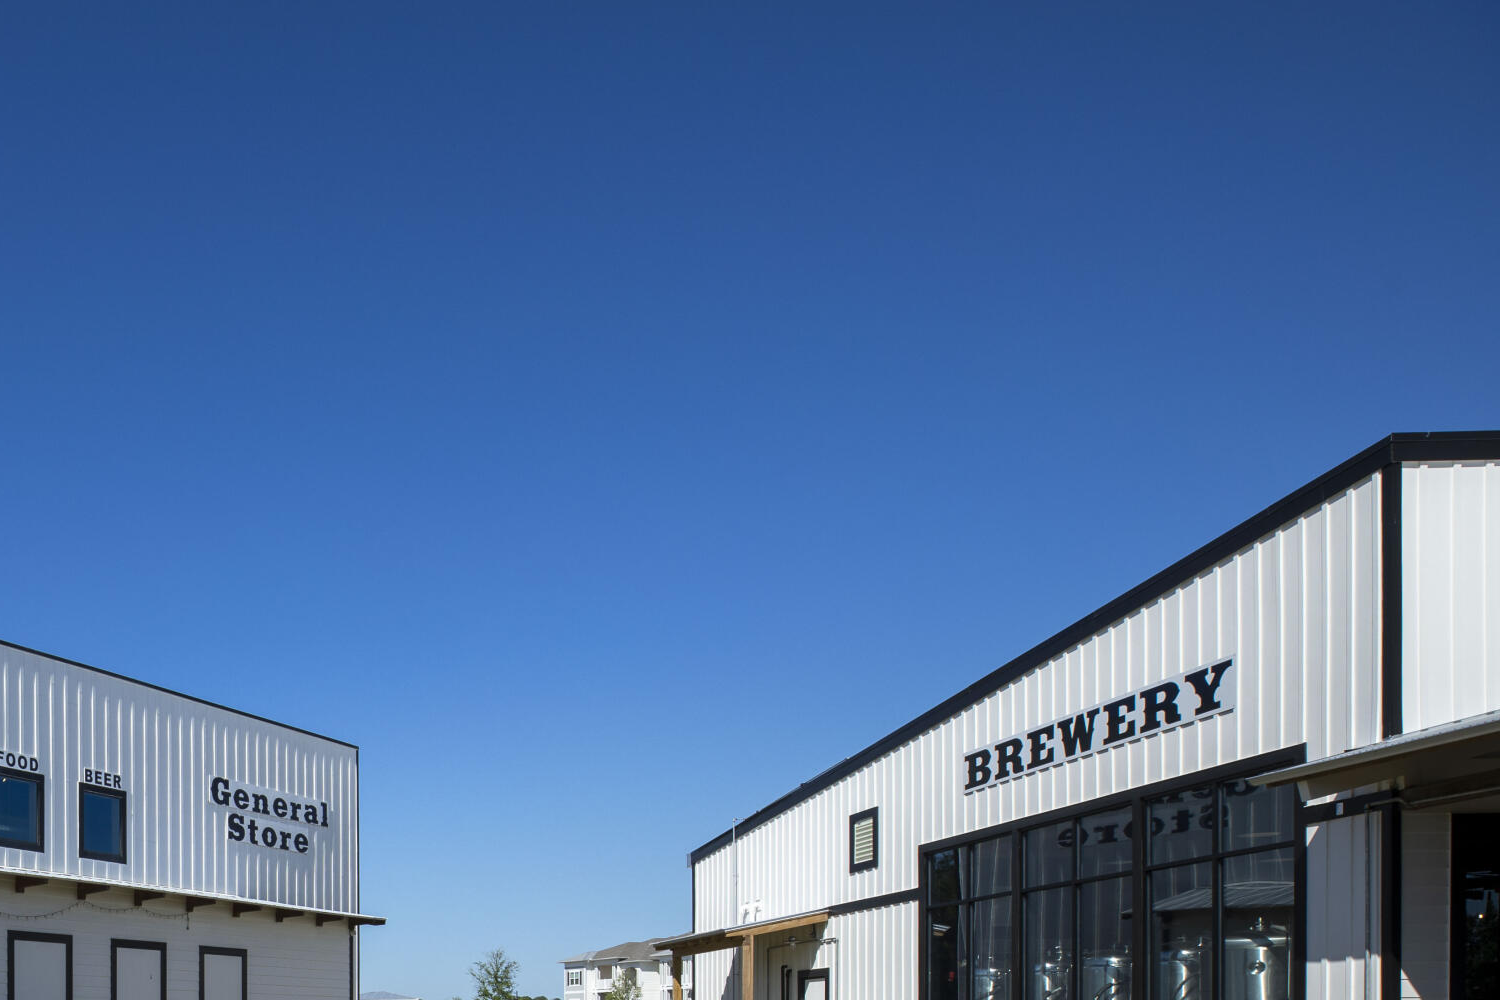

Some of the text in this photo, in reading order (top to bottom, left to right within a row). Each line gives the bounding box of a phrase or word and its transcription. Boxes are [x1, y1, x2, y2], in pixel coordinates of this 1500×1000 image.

[964, 659, 1233, 790] BREWERY
[84, 768, 122, 789] BEER
[211, 777, 328, 827] General
[228, 813, 309, 853] Store
